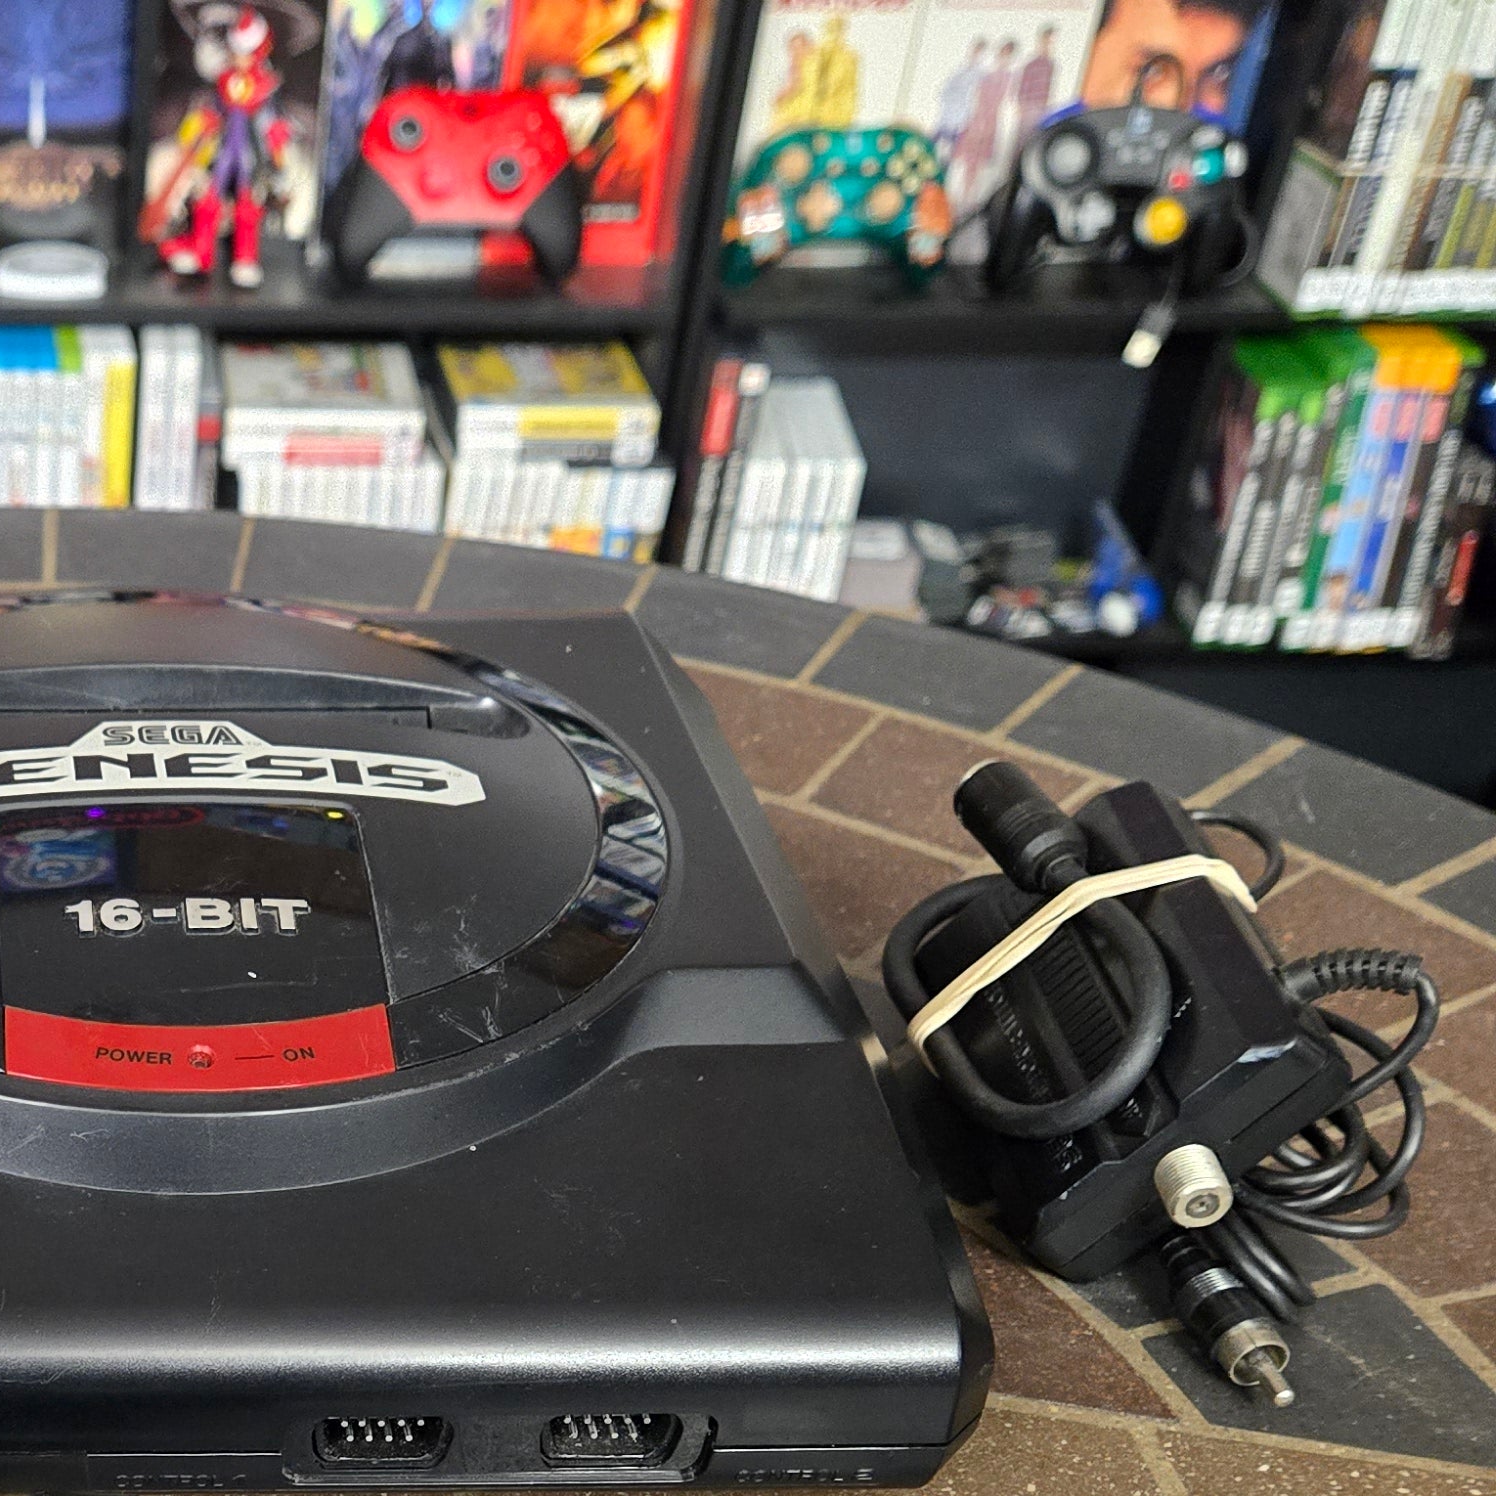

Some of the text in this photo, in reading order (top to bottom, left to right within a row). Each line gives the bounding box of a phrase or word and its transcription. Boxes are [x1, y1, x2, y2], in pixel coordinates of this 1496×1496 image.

[101, 724, 242, 746] SEGA
[64, 897, 311, 937] 16-BIT
[95, 1046, 316, 1065] POWER ON
[116, 1474, 224, 1488] CONTROL
[734, 1468, 844, 1483] CONTROL
